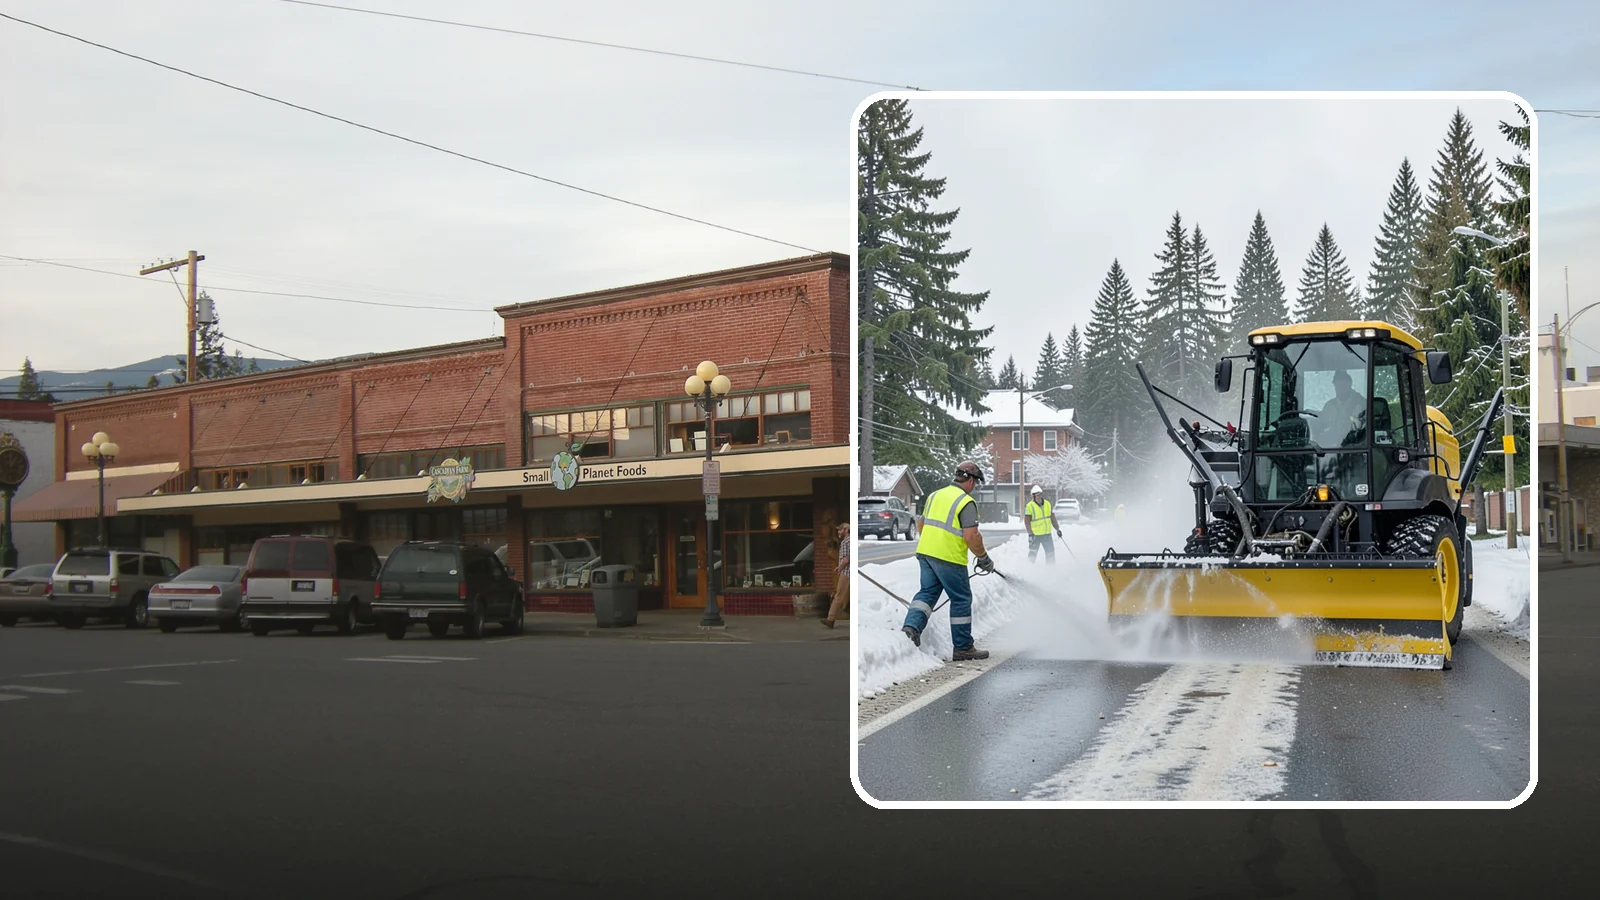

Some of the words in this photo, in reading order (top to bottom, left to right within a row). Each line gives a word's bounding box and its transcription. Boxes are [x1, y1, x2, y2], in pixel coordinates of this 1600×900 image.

[523, 471, 549, 483] Small
[583, 468, 614, 479] Planet
[617, 465, 647, 476] Foods
